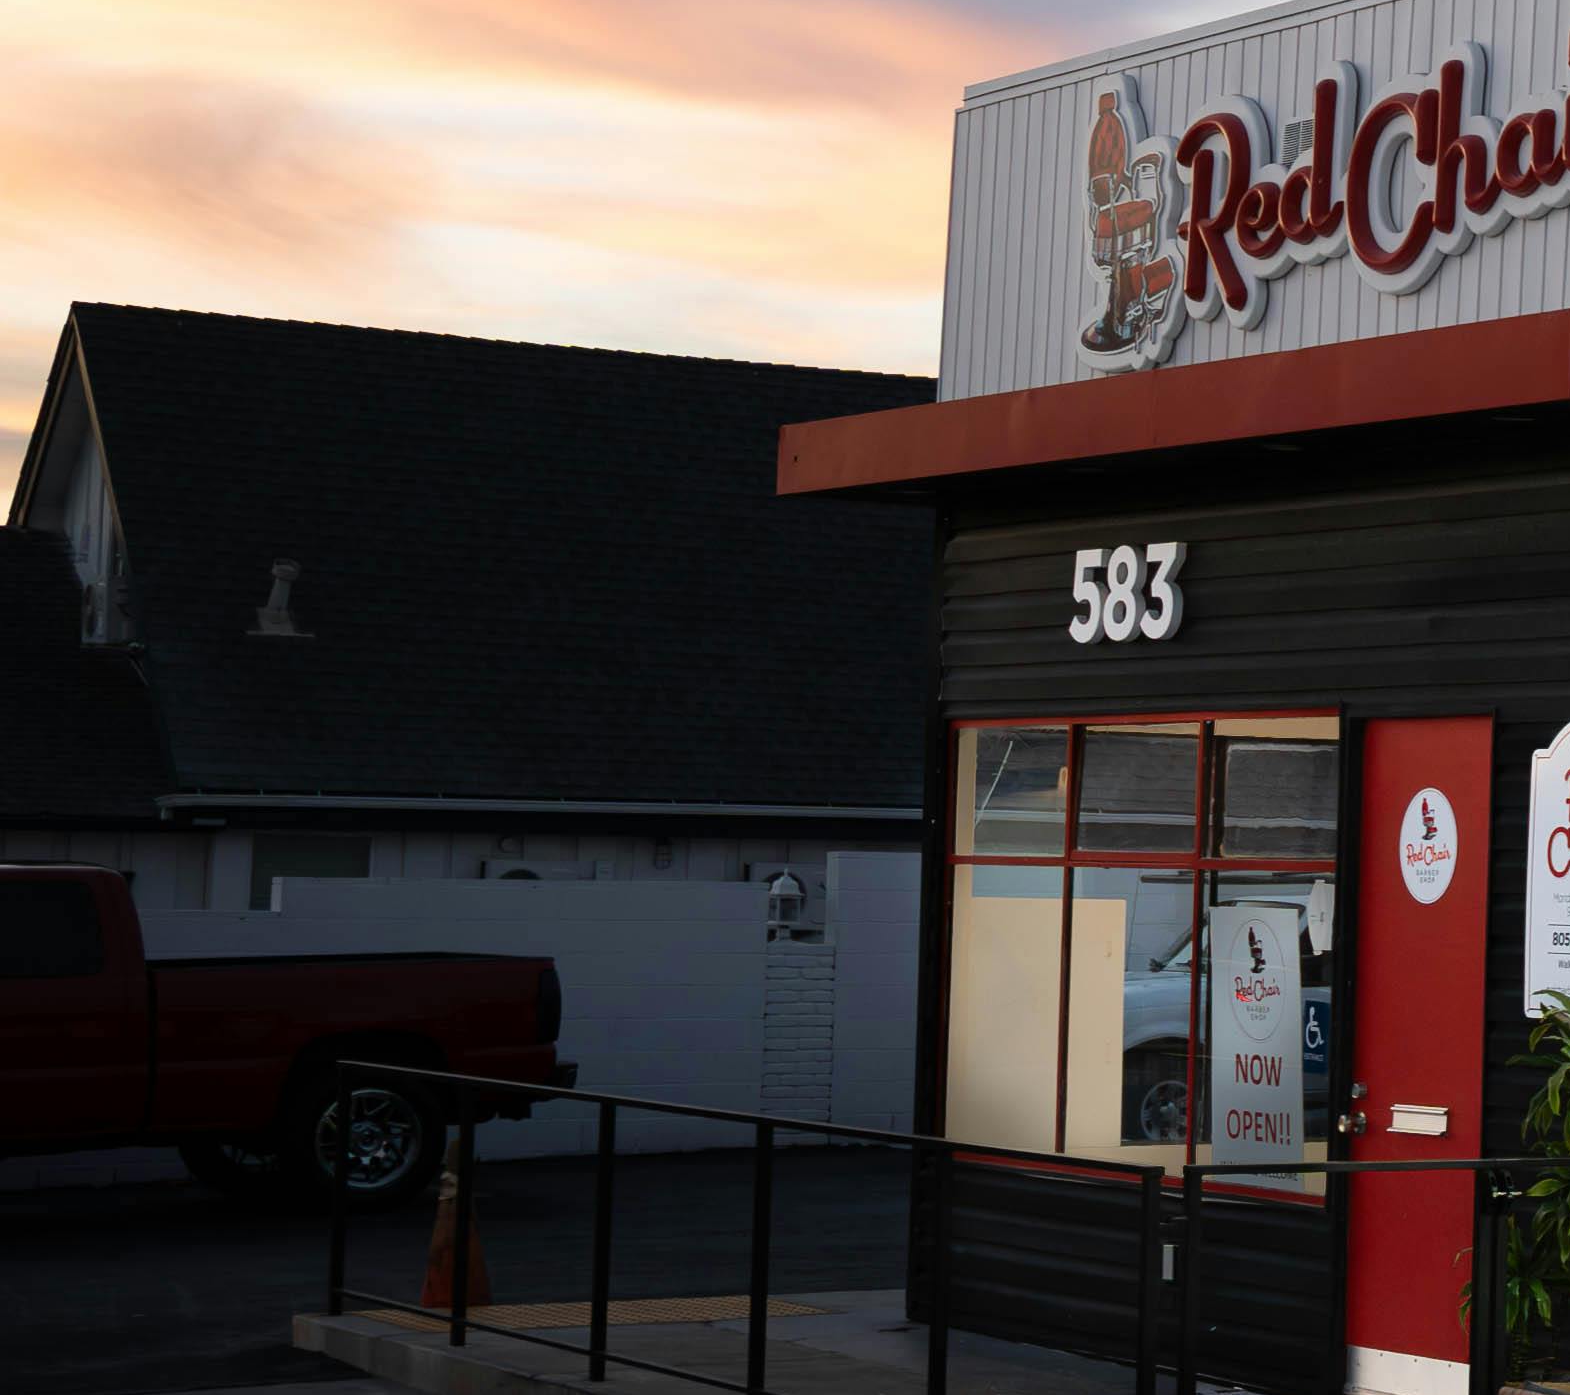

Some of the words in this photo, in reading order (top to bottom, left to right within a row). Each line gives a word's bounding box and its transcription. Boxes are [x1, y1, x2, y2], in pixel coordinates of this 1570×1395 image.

[1177, 78, 1345, 311] Red
[1069, 541, 1187, 645] 583
[1406, 842, 1423, 867] Red
[1424, 843, 1450, 866] Chair
[1234, 975, 1254, 999] Red
[1254, 977, 1280, 1001] Chair
[1235, 1052, 1283, 1088] NOW
[1226, 1108, 1292, 1146] OPEN!!
